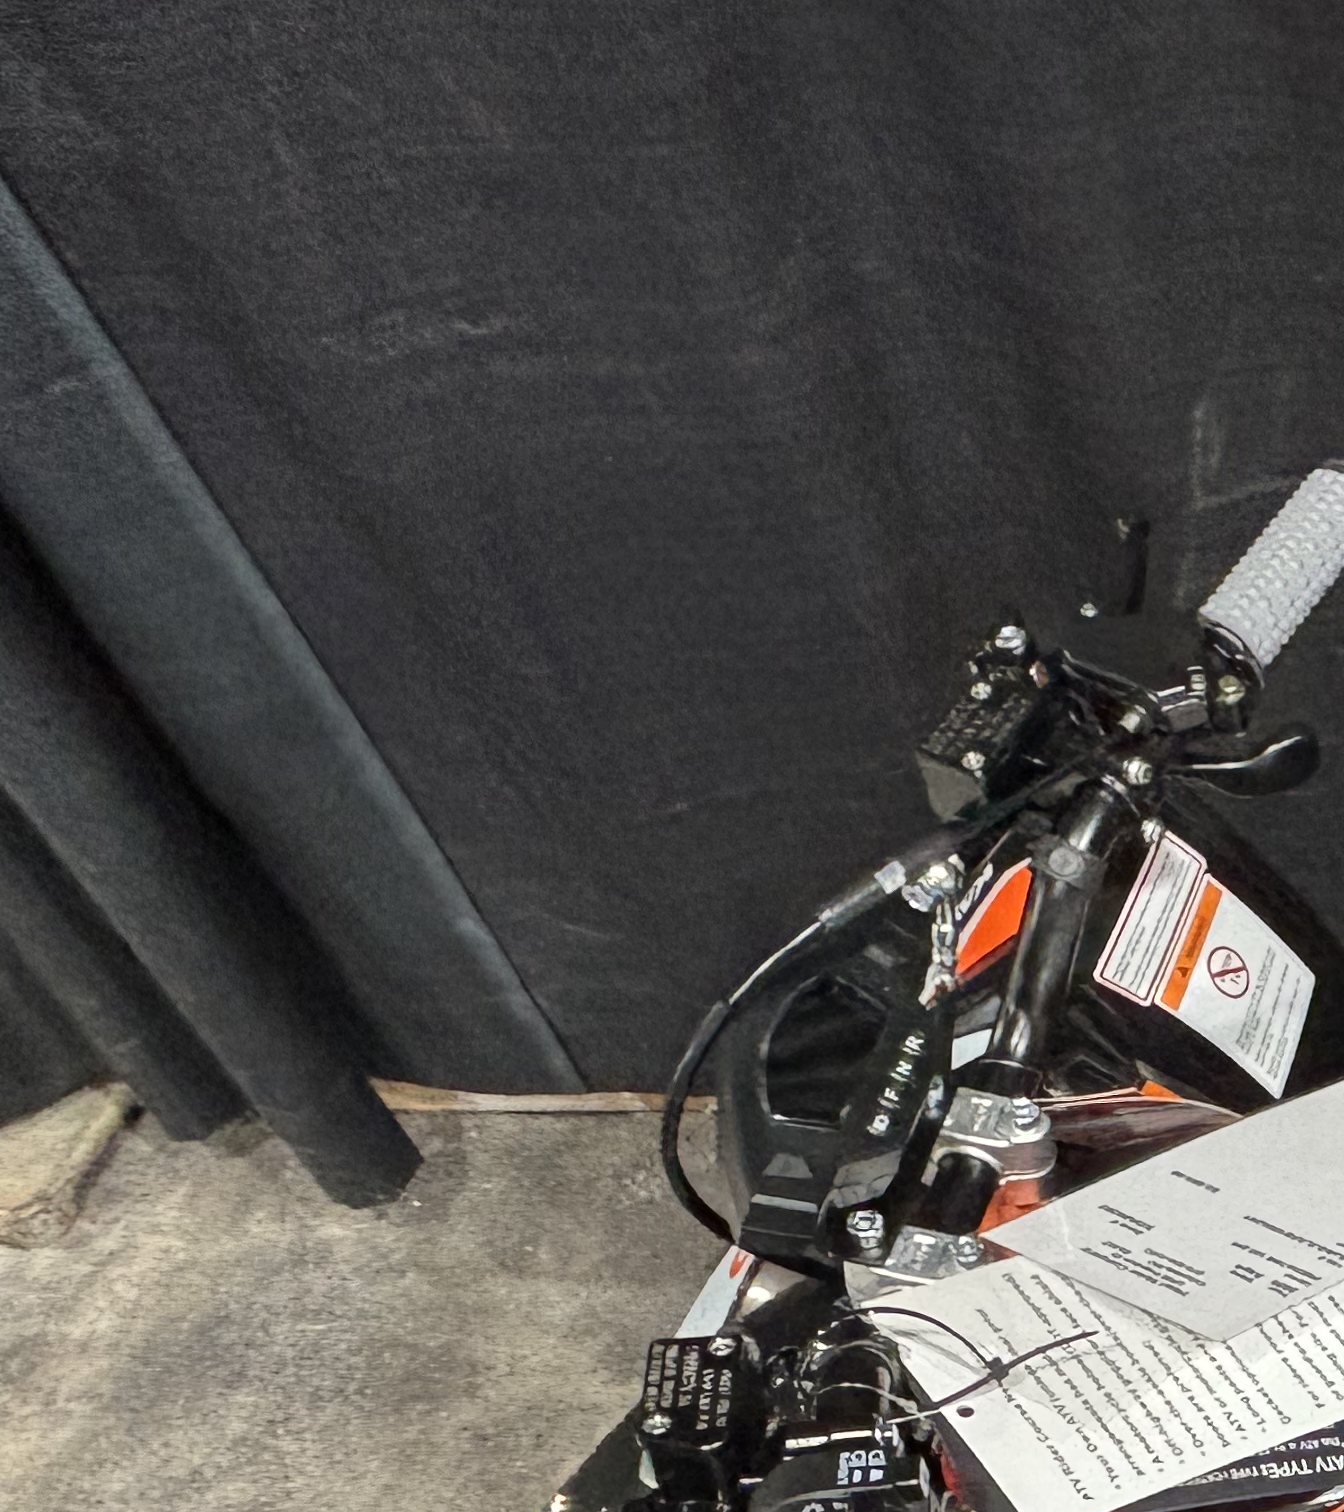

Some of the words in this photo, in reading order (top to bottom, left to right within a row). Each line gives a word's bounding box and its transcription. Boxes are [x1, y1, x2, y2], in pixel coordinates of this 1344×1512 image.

[1052, 1404, 1077, 1424] ATV
[1222, 1411, 1246, 1431] ATV
[1240, 1396, 1266, 1425] Long
[1075, 1426, 1097, 1452] Own
[1046, 1444, 1074, 1475] Rider
[1096, 1454, 1119, 1482] Your
[1315, 1454, 1344, 1472] ATV
[1069, 1478, 1094, 1500] ATV
